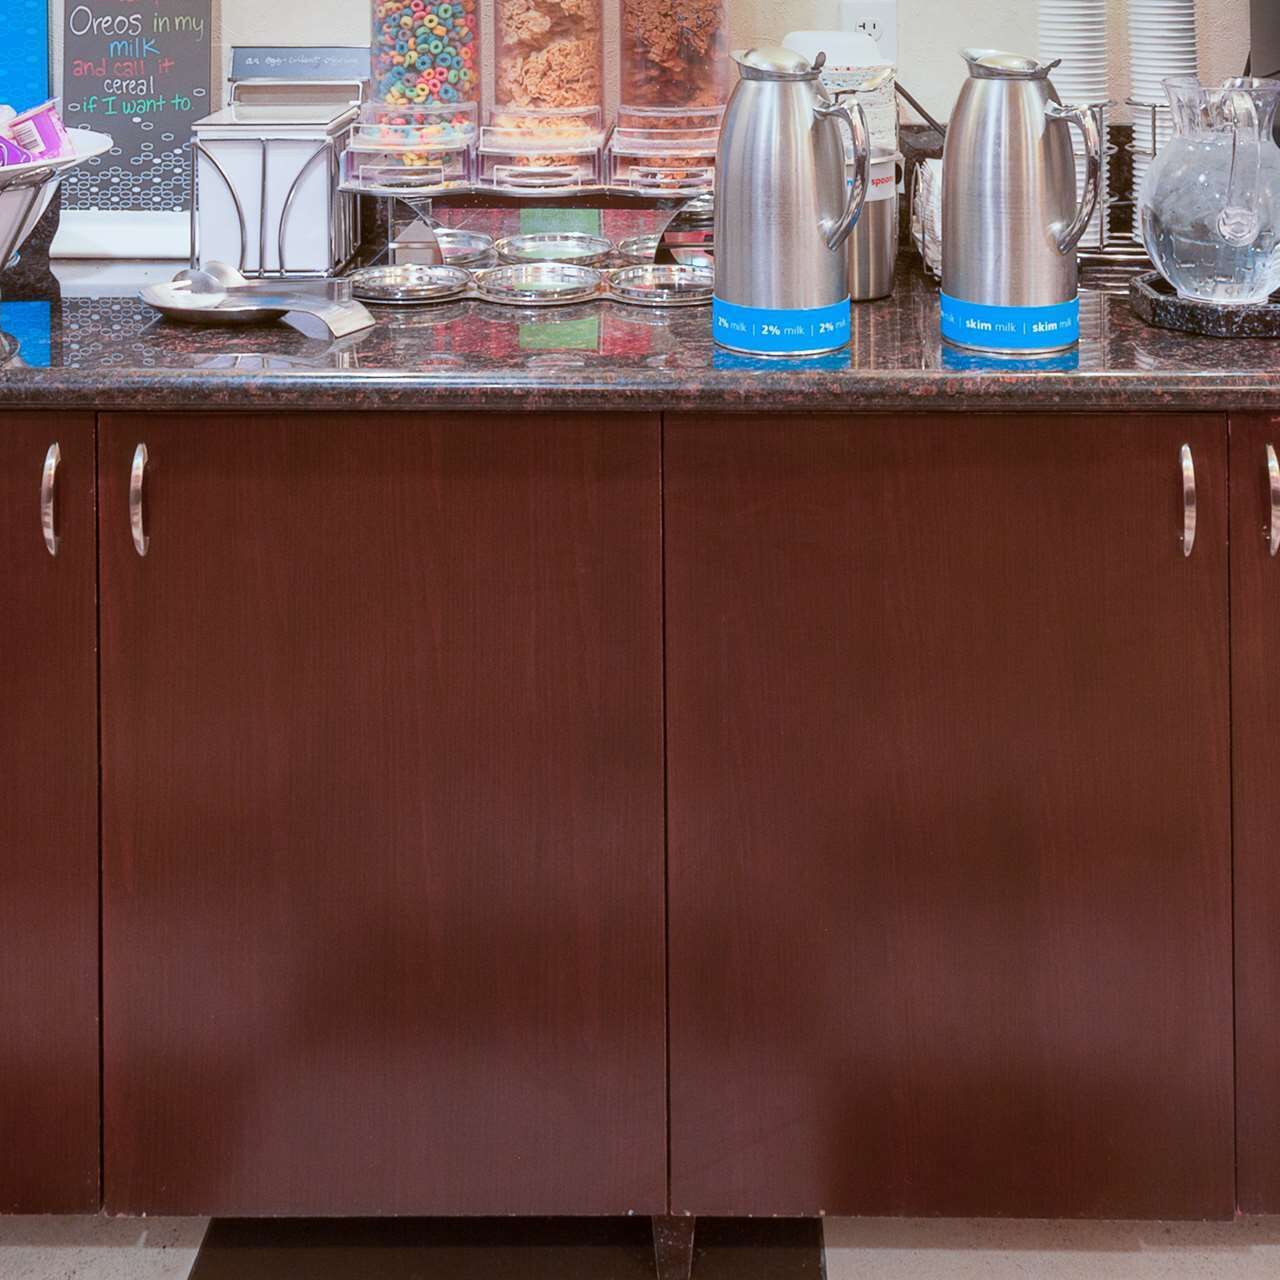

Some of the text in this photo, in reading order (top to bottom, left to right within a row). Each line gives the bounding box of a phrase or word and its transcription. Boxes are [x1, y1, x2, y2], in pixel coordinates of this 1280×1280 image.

[70, 5, 204, 41] Oreos in my
[108, 38, 160, 58] milk
[73, 57, 175, 77] and call it
[104, 75, 154, 96] cereal
[82, 96, 98, 113] if
[101, 96, 118, 115] I
[122, 94, 166, 114] want
[718, 316, 729, 329] 2%
[730, 320, 747, 332] milk
[761, 325, 781, 336] 2%
[784, 325, 805, 335] milk
[819, 323, 834, 334] 2%
[965, 319, 992, 331] skim
[995, 322, 1017, 333] milk
[1032, 322, 1058, 333] skim
